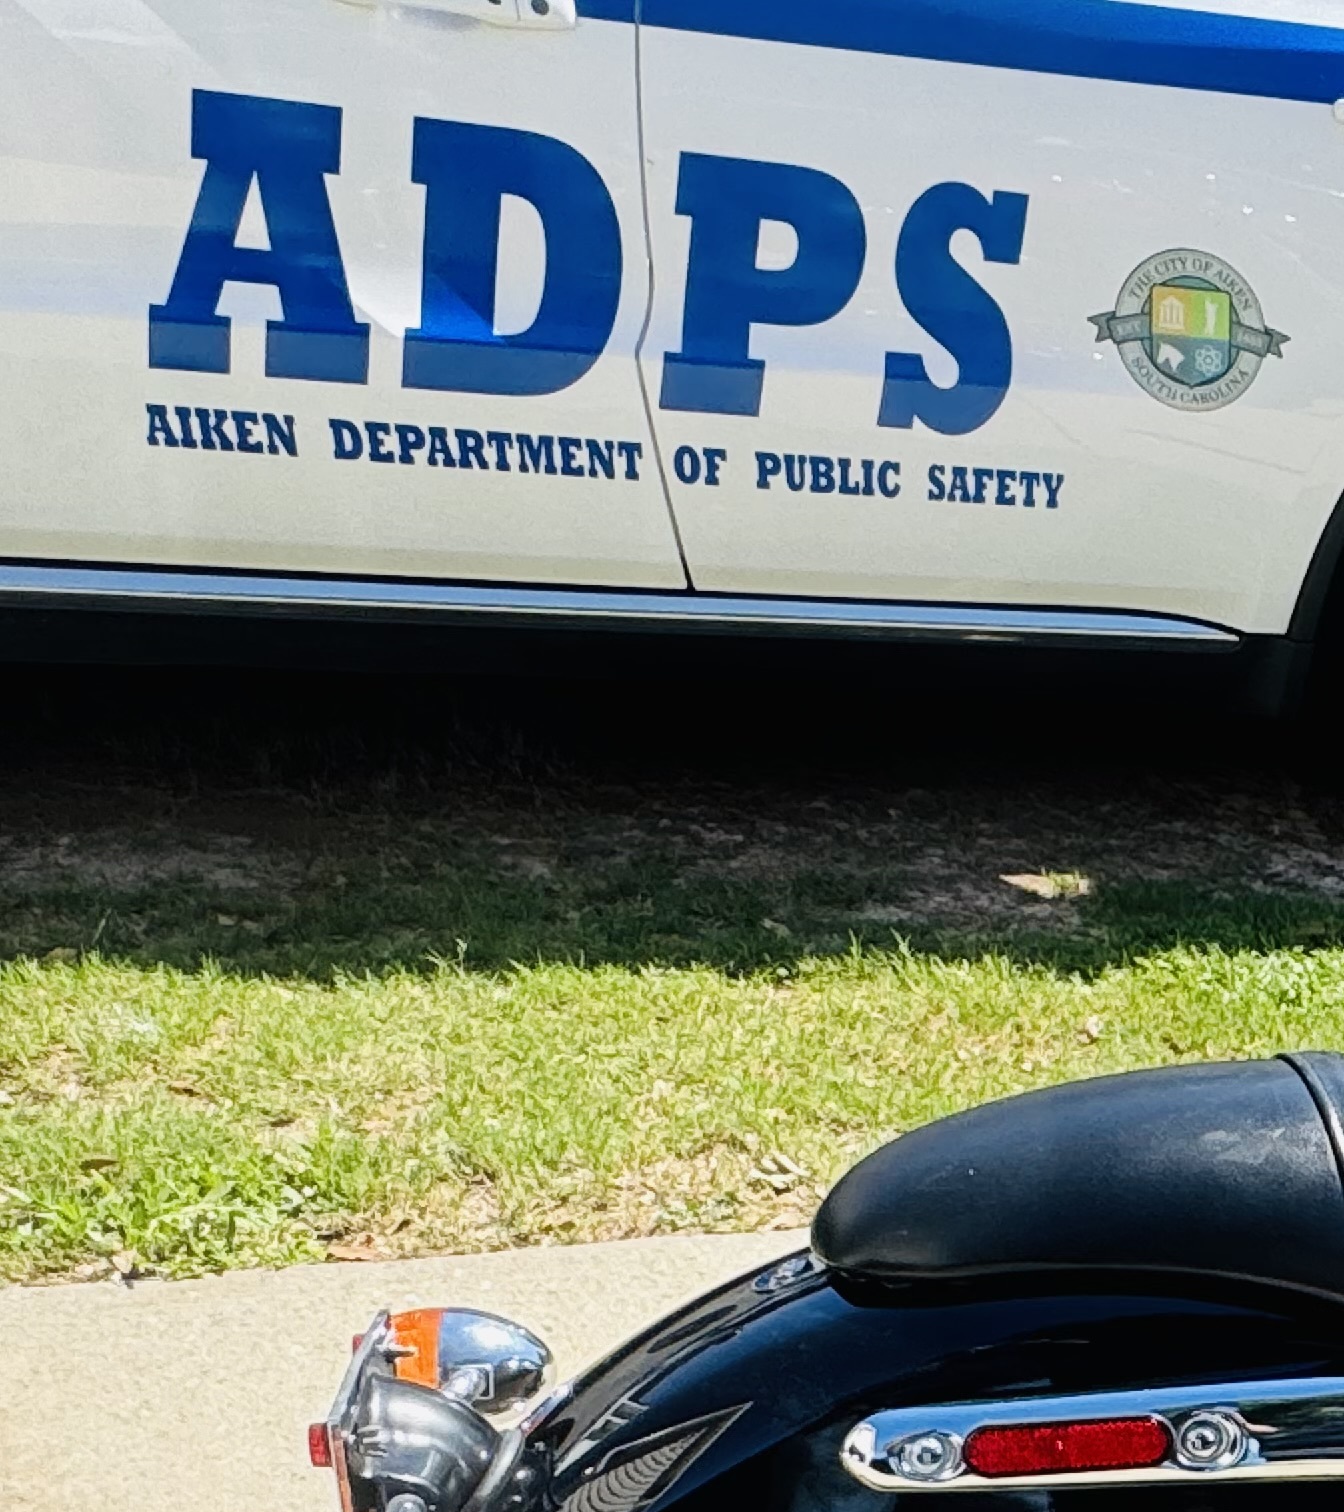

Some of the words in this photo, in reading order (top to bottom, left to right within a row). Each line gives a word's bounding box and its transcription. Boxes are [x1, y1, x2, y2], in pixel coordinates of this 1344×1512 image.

[149, 88, 1030, 436] ADPS
[1154, 256, 1188, 277] CITY
[1192, 258, 1215, 274] OF
[1180, 366, 1250, 405] CAROLINA
[146, 404, 297, 457] AIKEN
[328, 418, 644, 483] DEPARTMENT
[673, 446, 727, 486] OF
[756, 451, 901, 498] PUBLIC
[927, 465, 1065, 510] SAFETY
